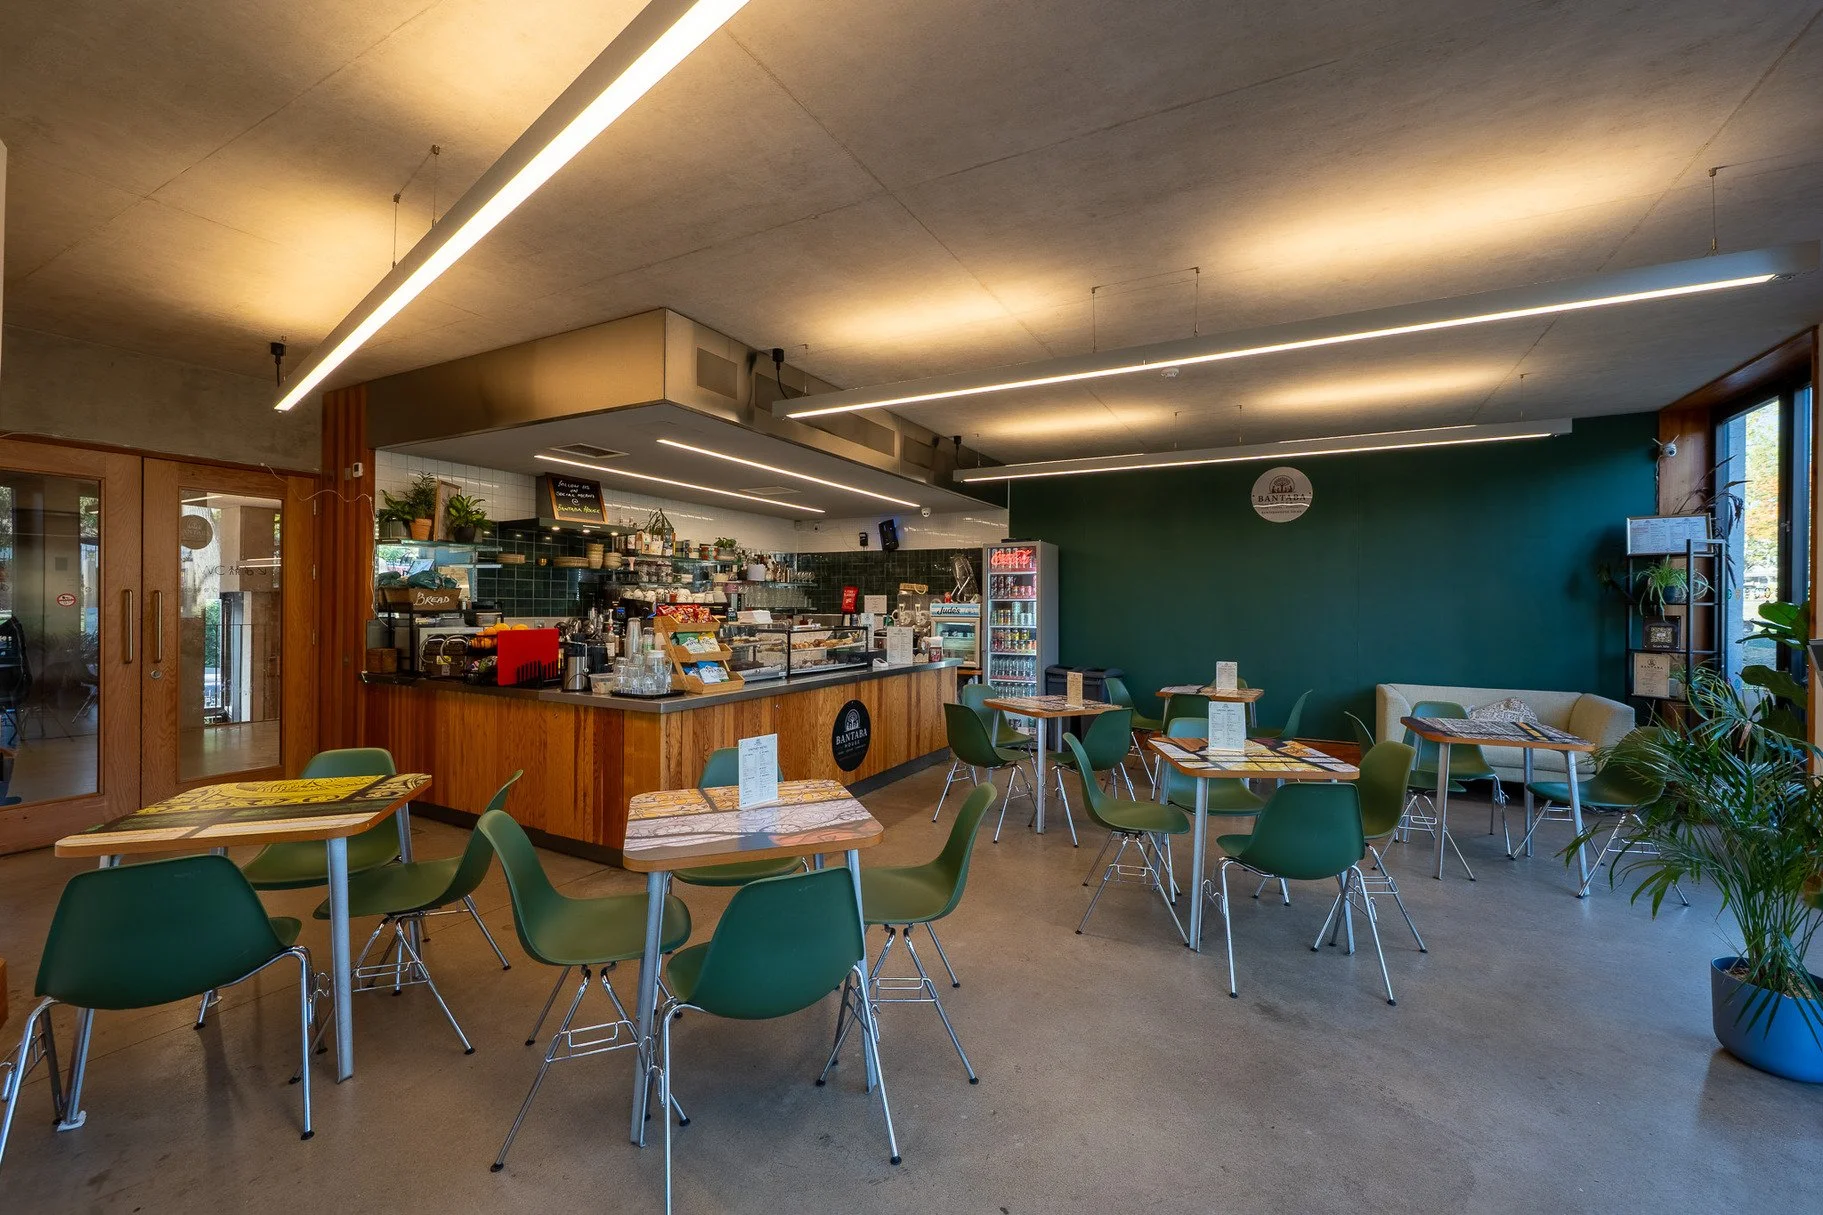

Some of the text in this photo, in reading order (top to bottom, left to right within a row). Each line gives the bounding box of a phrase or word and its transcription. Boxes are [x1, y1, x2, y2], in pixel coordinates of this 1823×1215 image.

[1258, 494, 1306, 502] BANTABA
[413, 592, 450, 606] BREAD
[937, 606, 960, 615] Jude's
[836, 728, 868, 745] BANTABA
